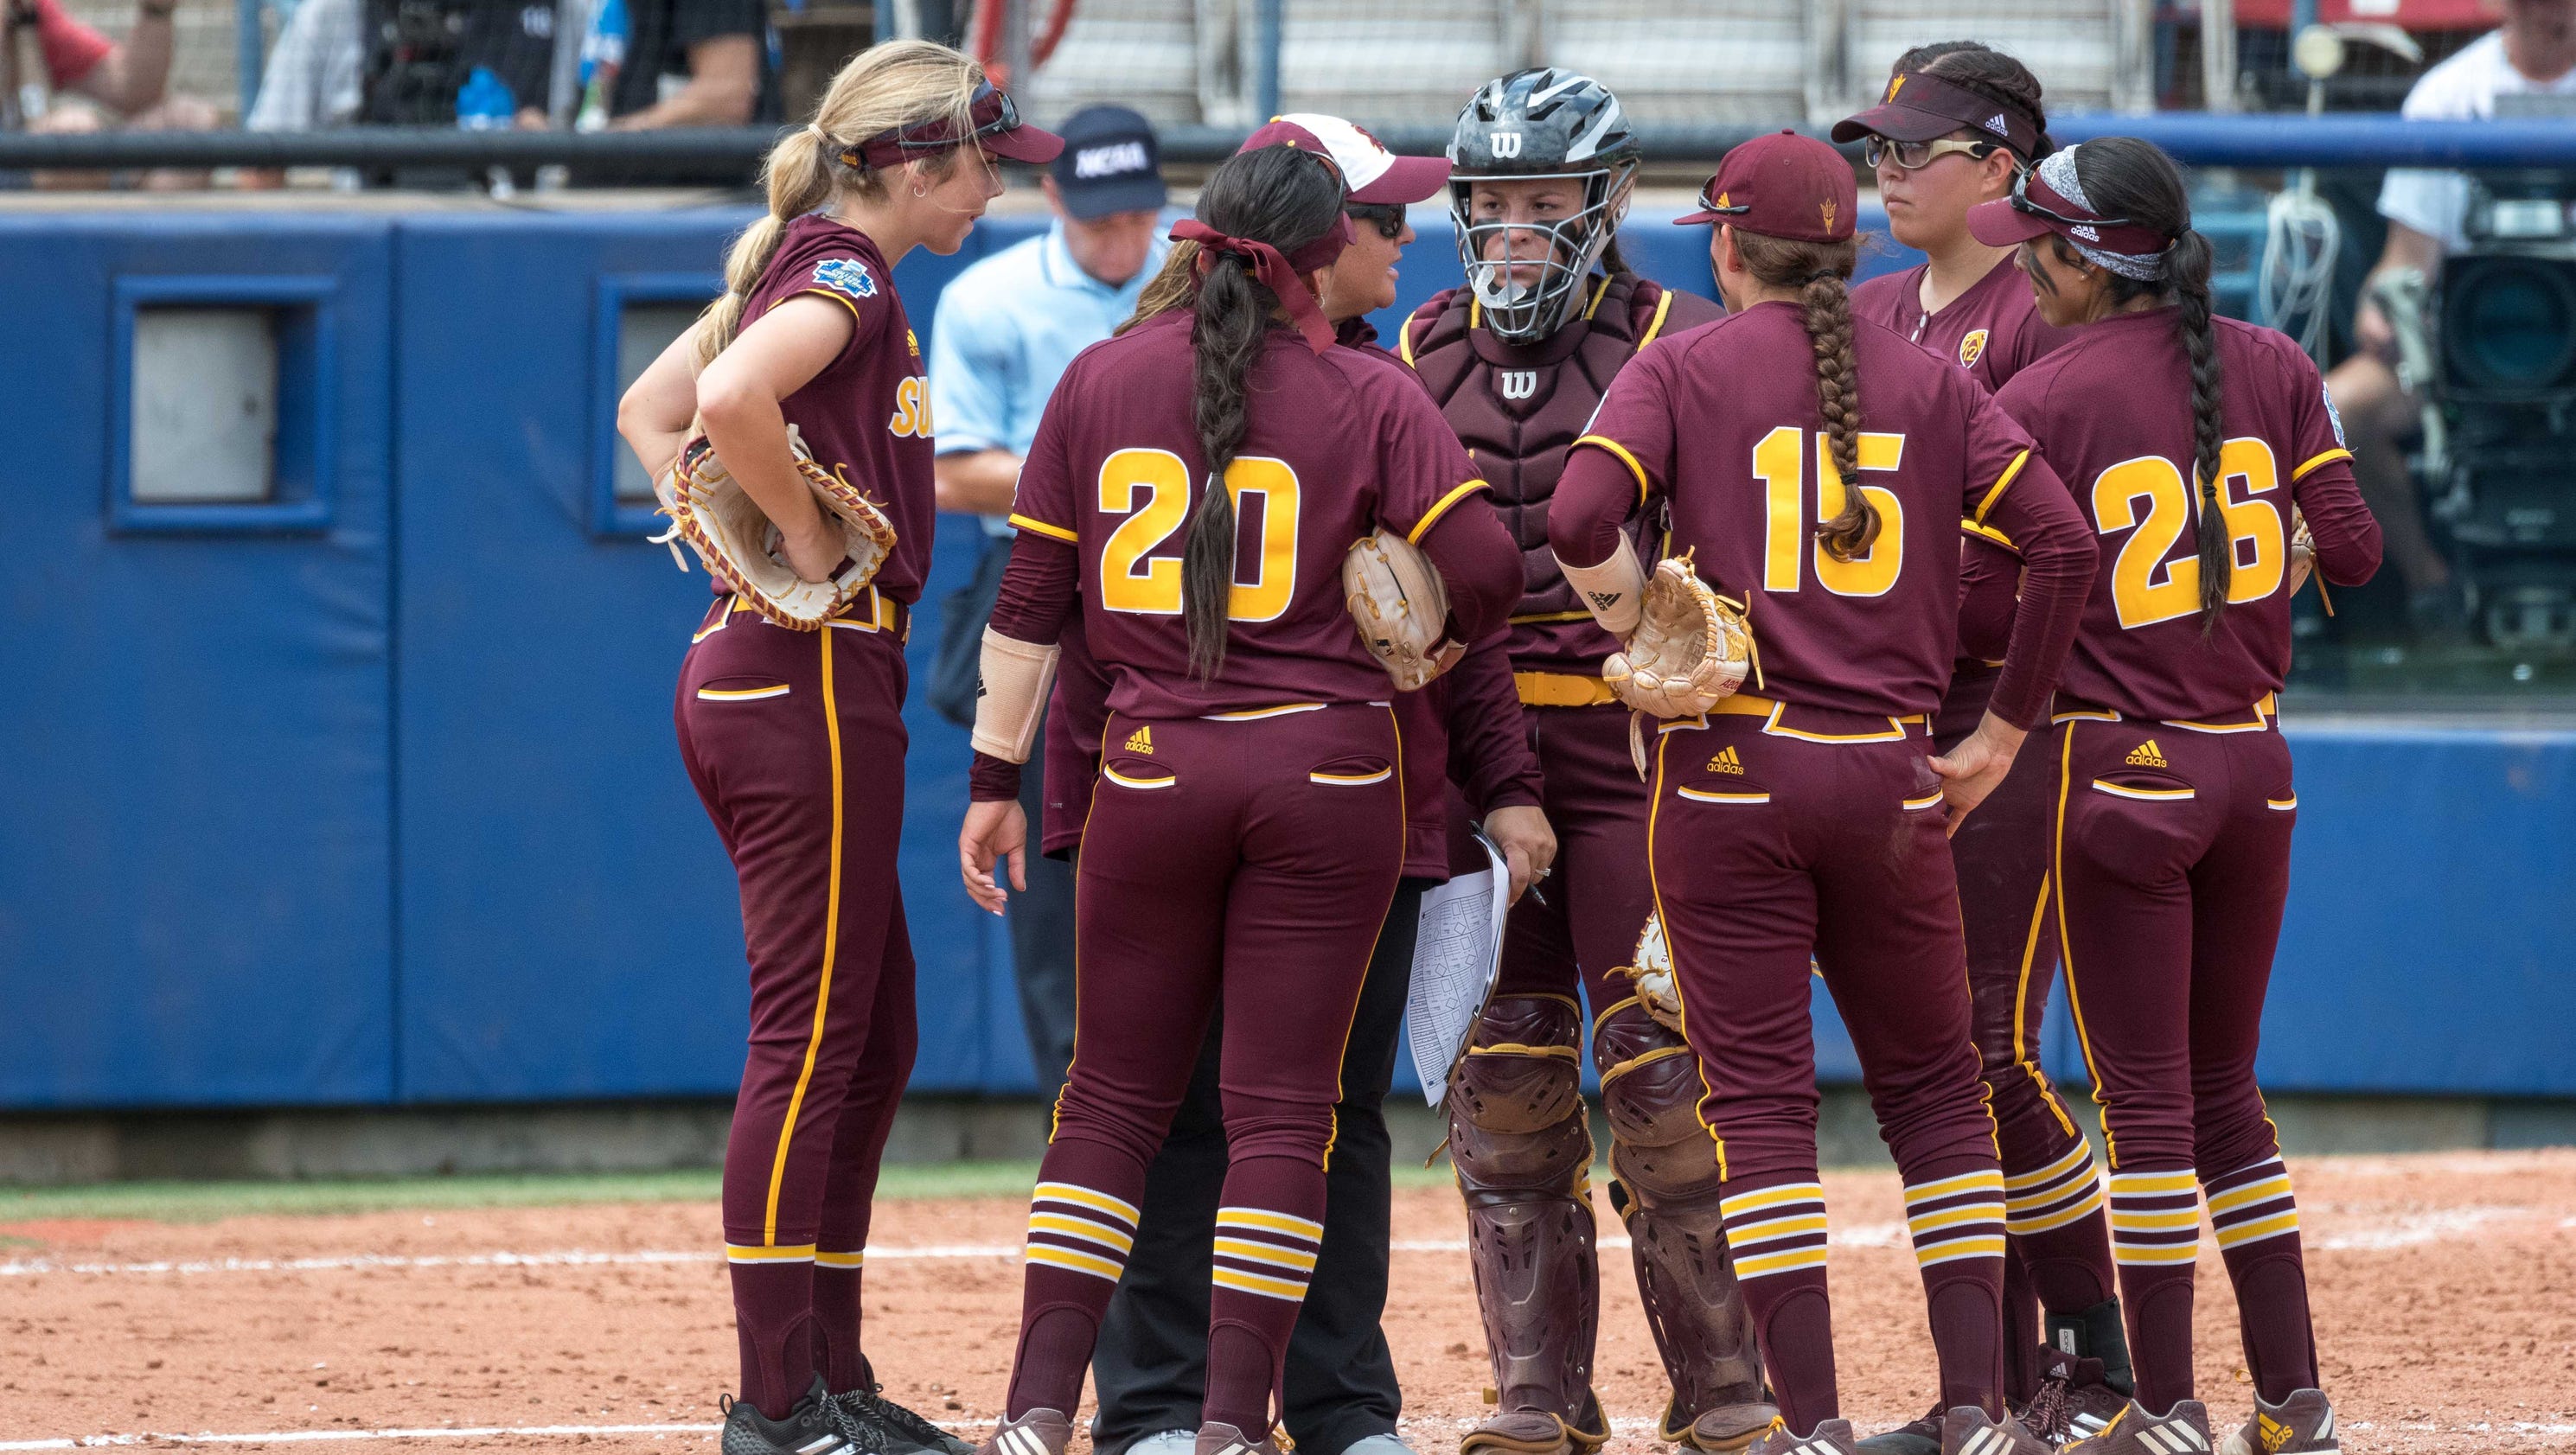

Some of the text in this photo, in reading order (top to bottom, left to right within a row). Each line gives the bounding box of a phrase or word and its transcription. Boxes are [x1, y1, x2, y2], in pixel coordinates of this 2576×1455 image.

[1985, 120, 2009, 137] adidas
[1075, 142, 1147, 178] NCAA
[2071, 227, 2100, 242] adidas
[1964, 346, 1978, 361] 12
[1753, 426, 1906, 597] 15
[1098, 448, 1301, 622] 20
[2092, 437, 2285, 630] 26
[1125, 741, 1154, 755] adidas
[1706, 762, 1744, 775] adidas
[2125, 755, 2168, 768] adidas
